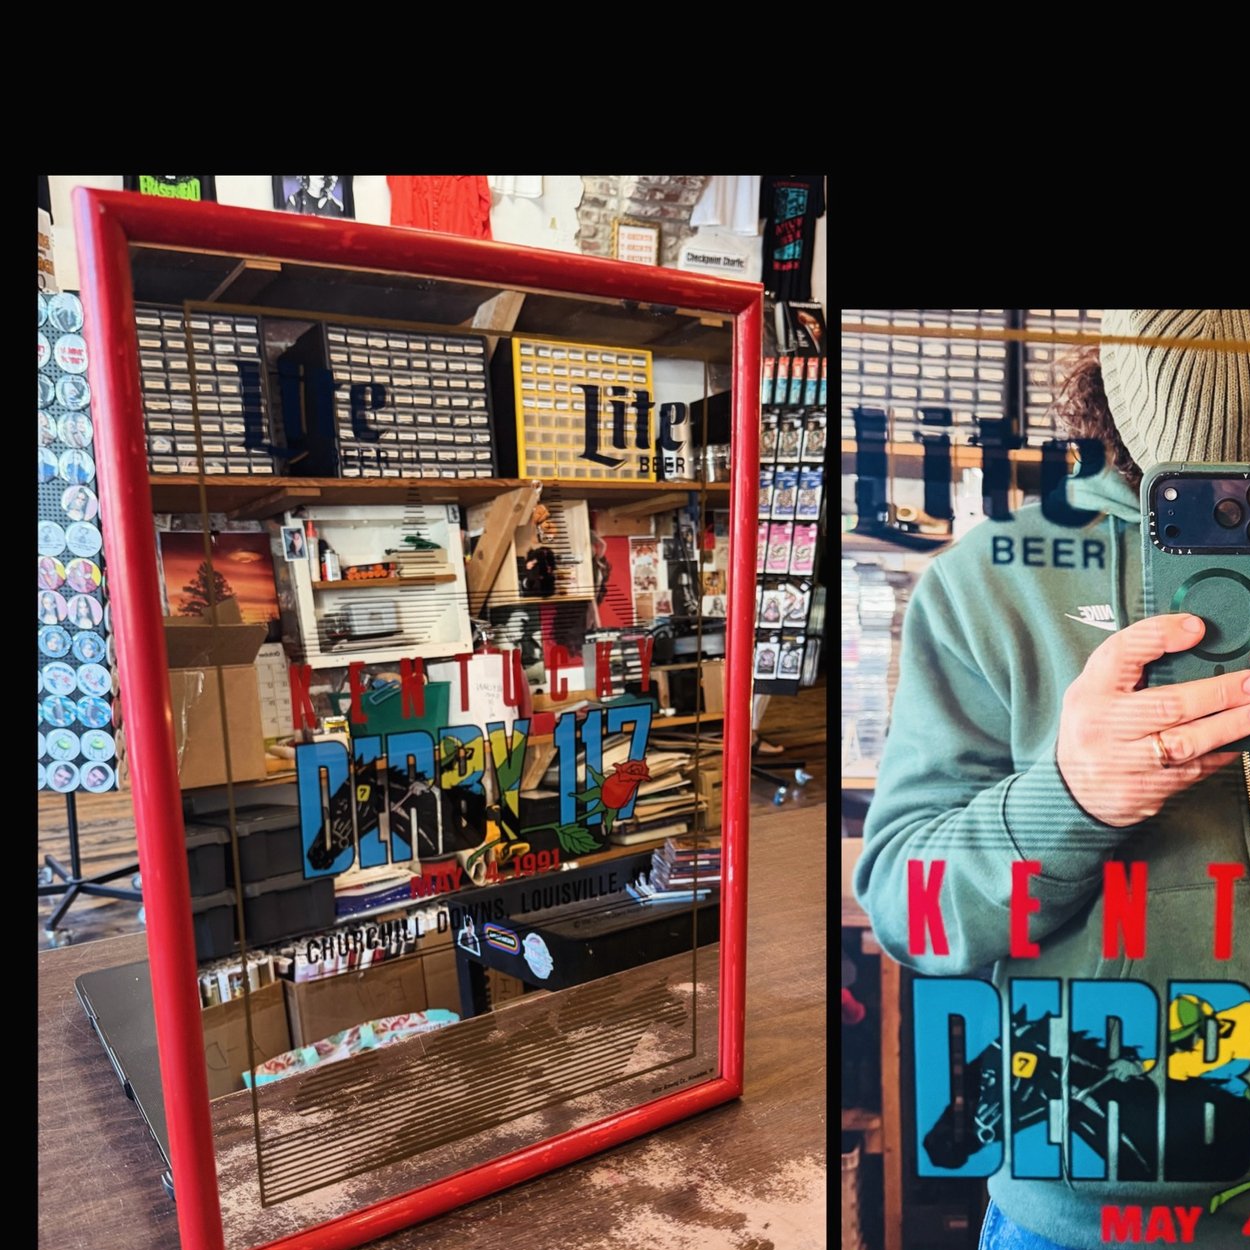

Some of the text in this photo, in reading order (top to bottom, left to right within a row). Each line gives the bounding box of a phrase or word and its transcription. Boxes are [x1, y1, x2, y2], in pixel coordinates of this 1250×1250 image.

[576, 384, 686, 468] Lite
[639, 456, 685, 474] BEER
[850, 405, 1108, 552] Lite
[991, 535, 1106, 569] BEER
[289, 636, 655, 731] KENTUCKY
[295, 704, 652, 881] DERBY 117
[410, 868, 463, 900] MAY
[513, 848, 560, 878] 1991
[306, 911, 427, 965] CHURCHILL
[520, 873, 625, 912] LOUISVILLE,
[1100, 1206, 1201, 1245] MAY
